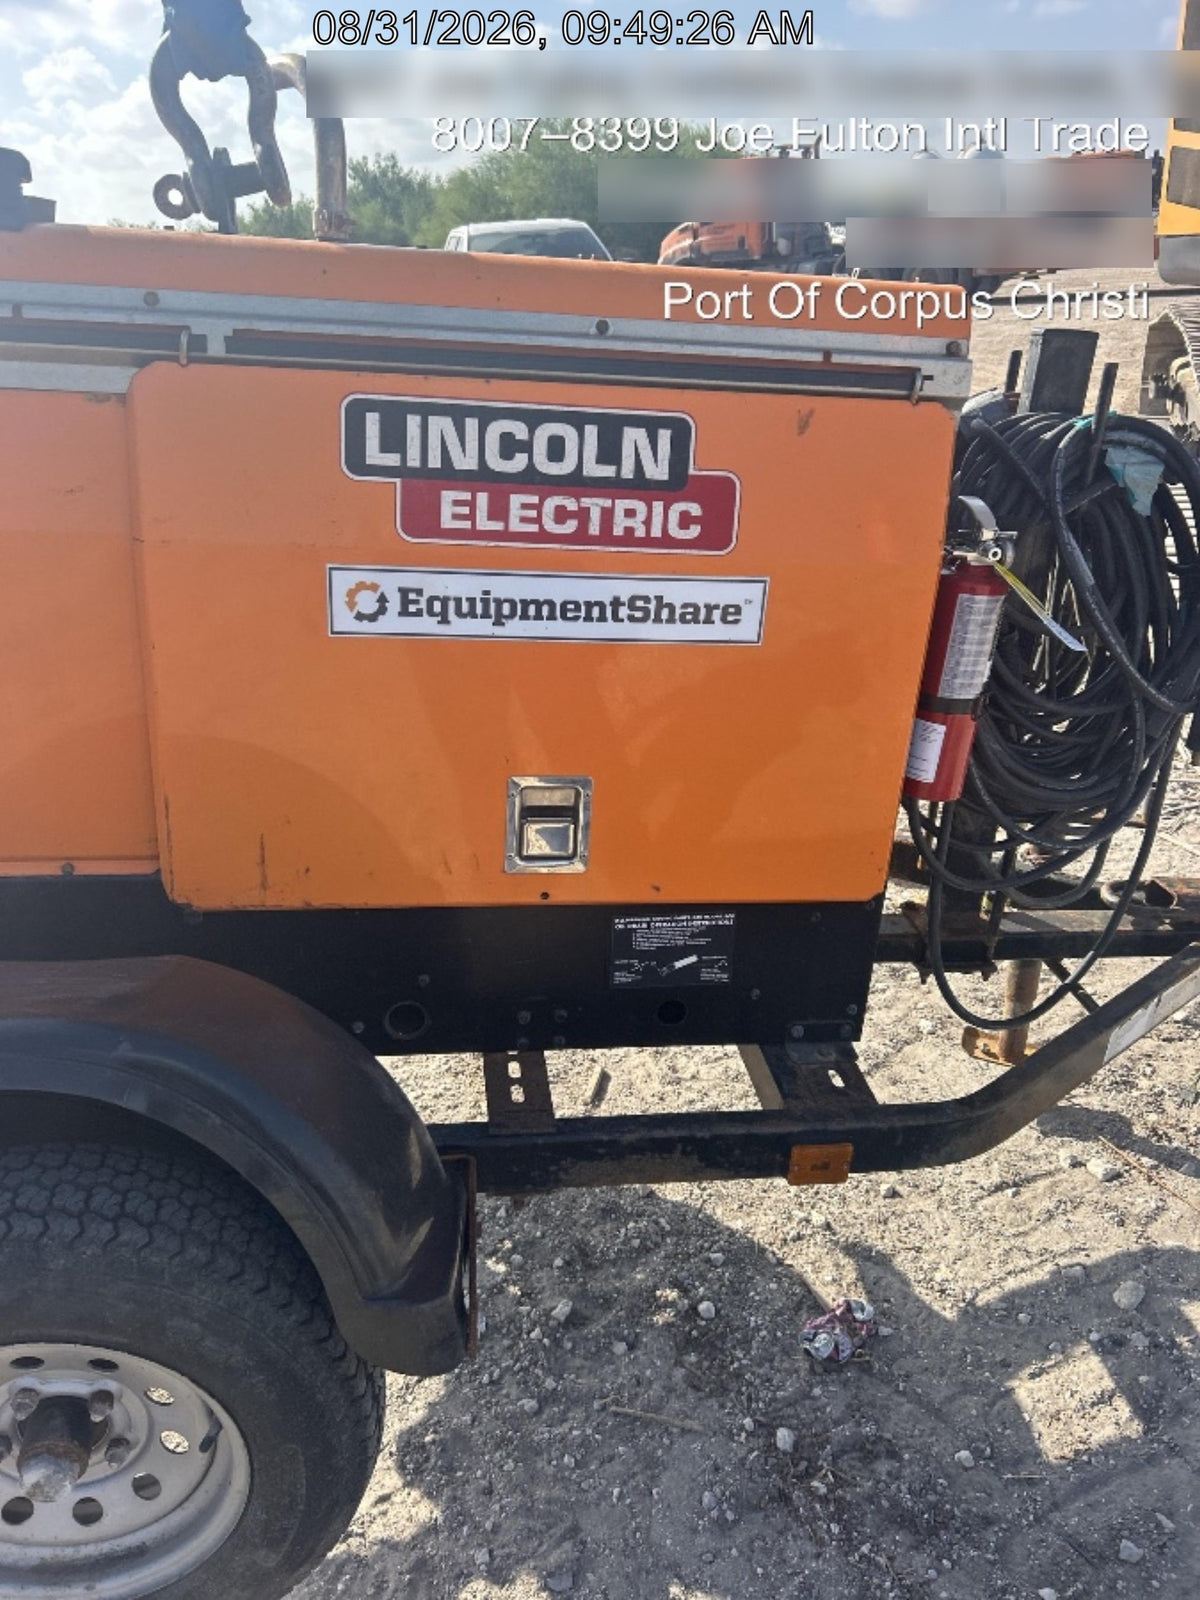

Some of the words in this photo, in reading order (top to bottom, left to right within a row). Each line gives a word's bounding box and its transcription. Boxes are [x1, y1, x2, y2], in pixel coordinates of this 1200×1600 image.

[364, 411, 673, 482] LINCOLN
[439, 489, 704, 541] ELECTRIC
[397, 586, 743, 627] EquipmentShare
